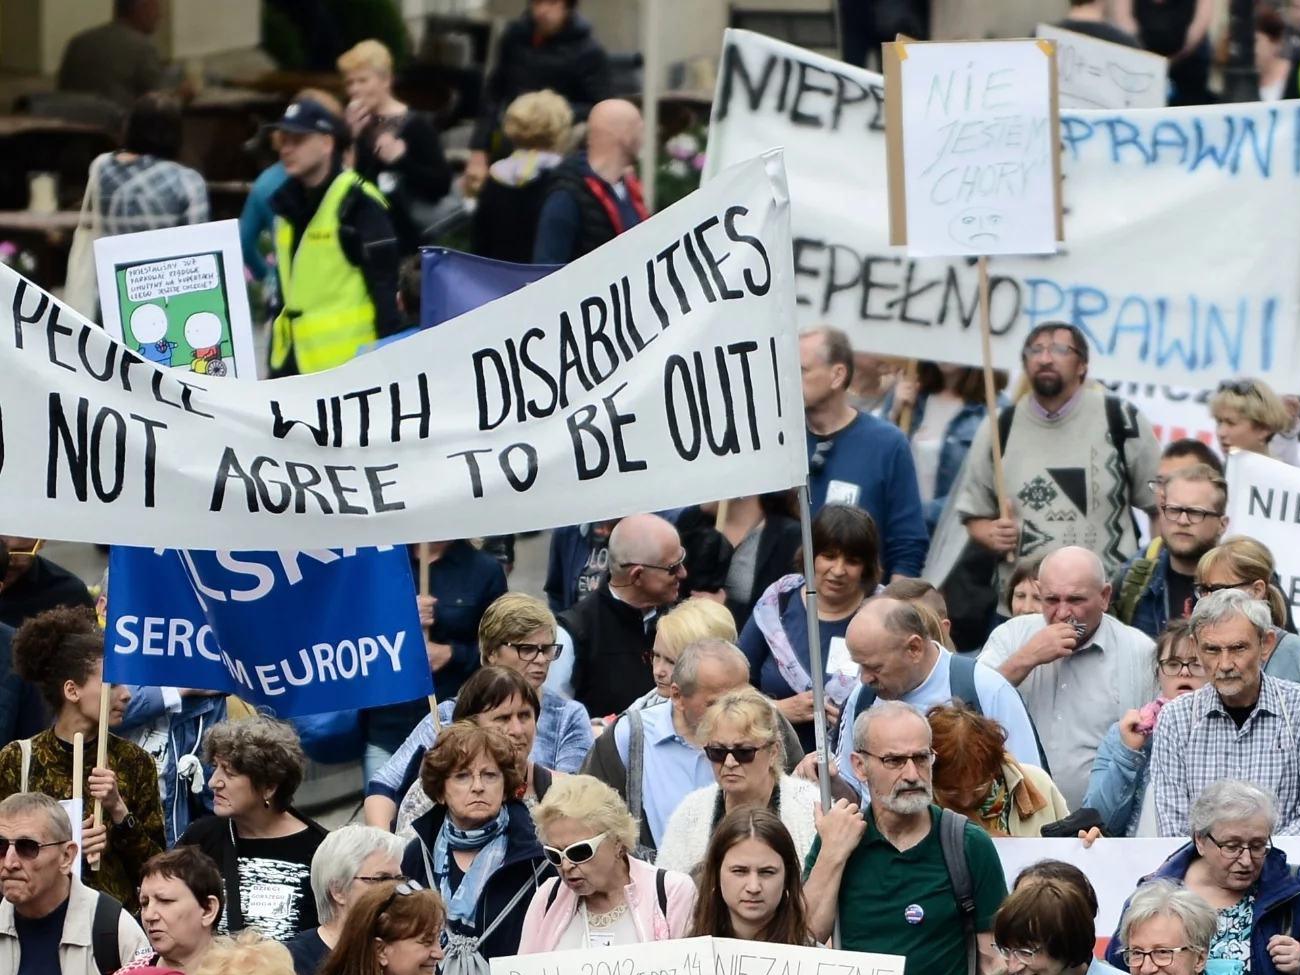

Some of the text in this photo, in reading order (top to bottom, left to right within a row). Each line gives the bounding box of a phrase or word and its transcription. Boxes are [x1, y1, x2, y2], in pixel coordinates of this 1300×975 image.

[930, 160, 1040, 206] CHORY
[270, 373, 432, 450] WITH
[472, 205, 772, 432] DISABILITIES
[46, 392, 168, 508] NOT
[209, 446, 407, 516] AGREE
[447, 442, 539, 498] TO
[566, 382, 648, 481] BE
[664, 337, 785, 462] OUT!
[254, 630, 406, 696] EUROPY
